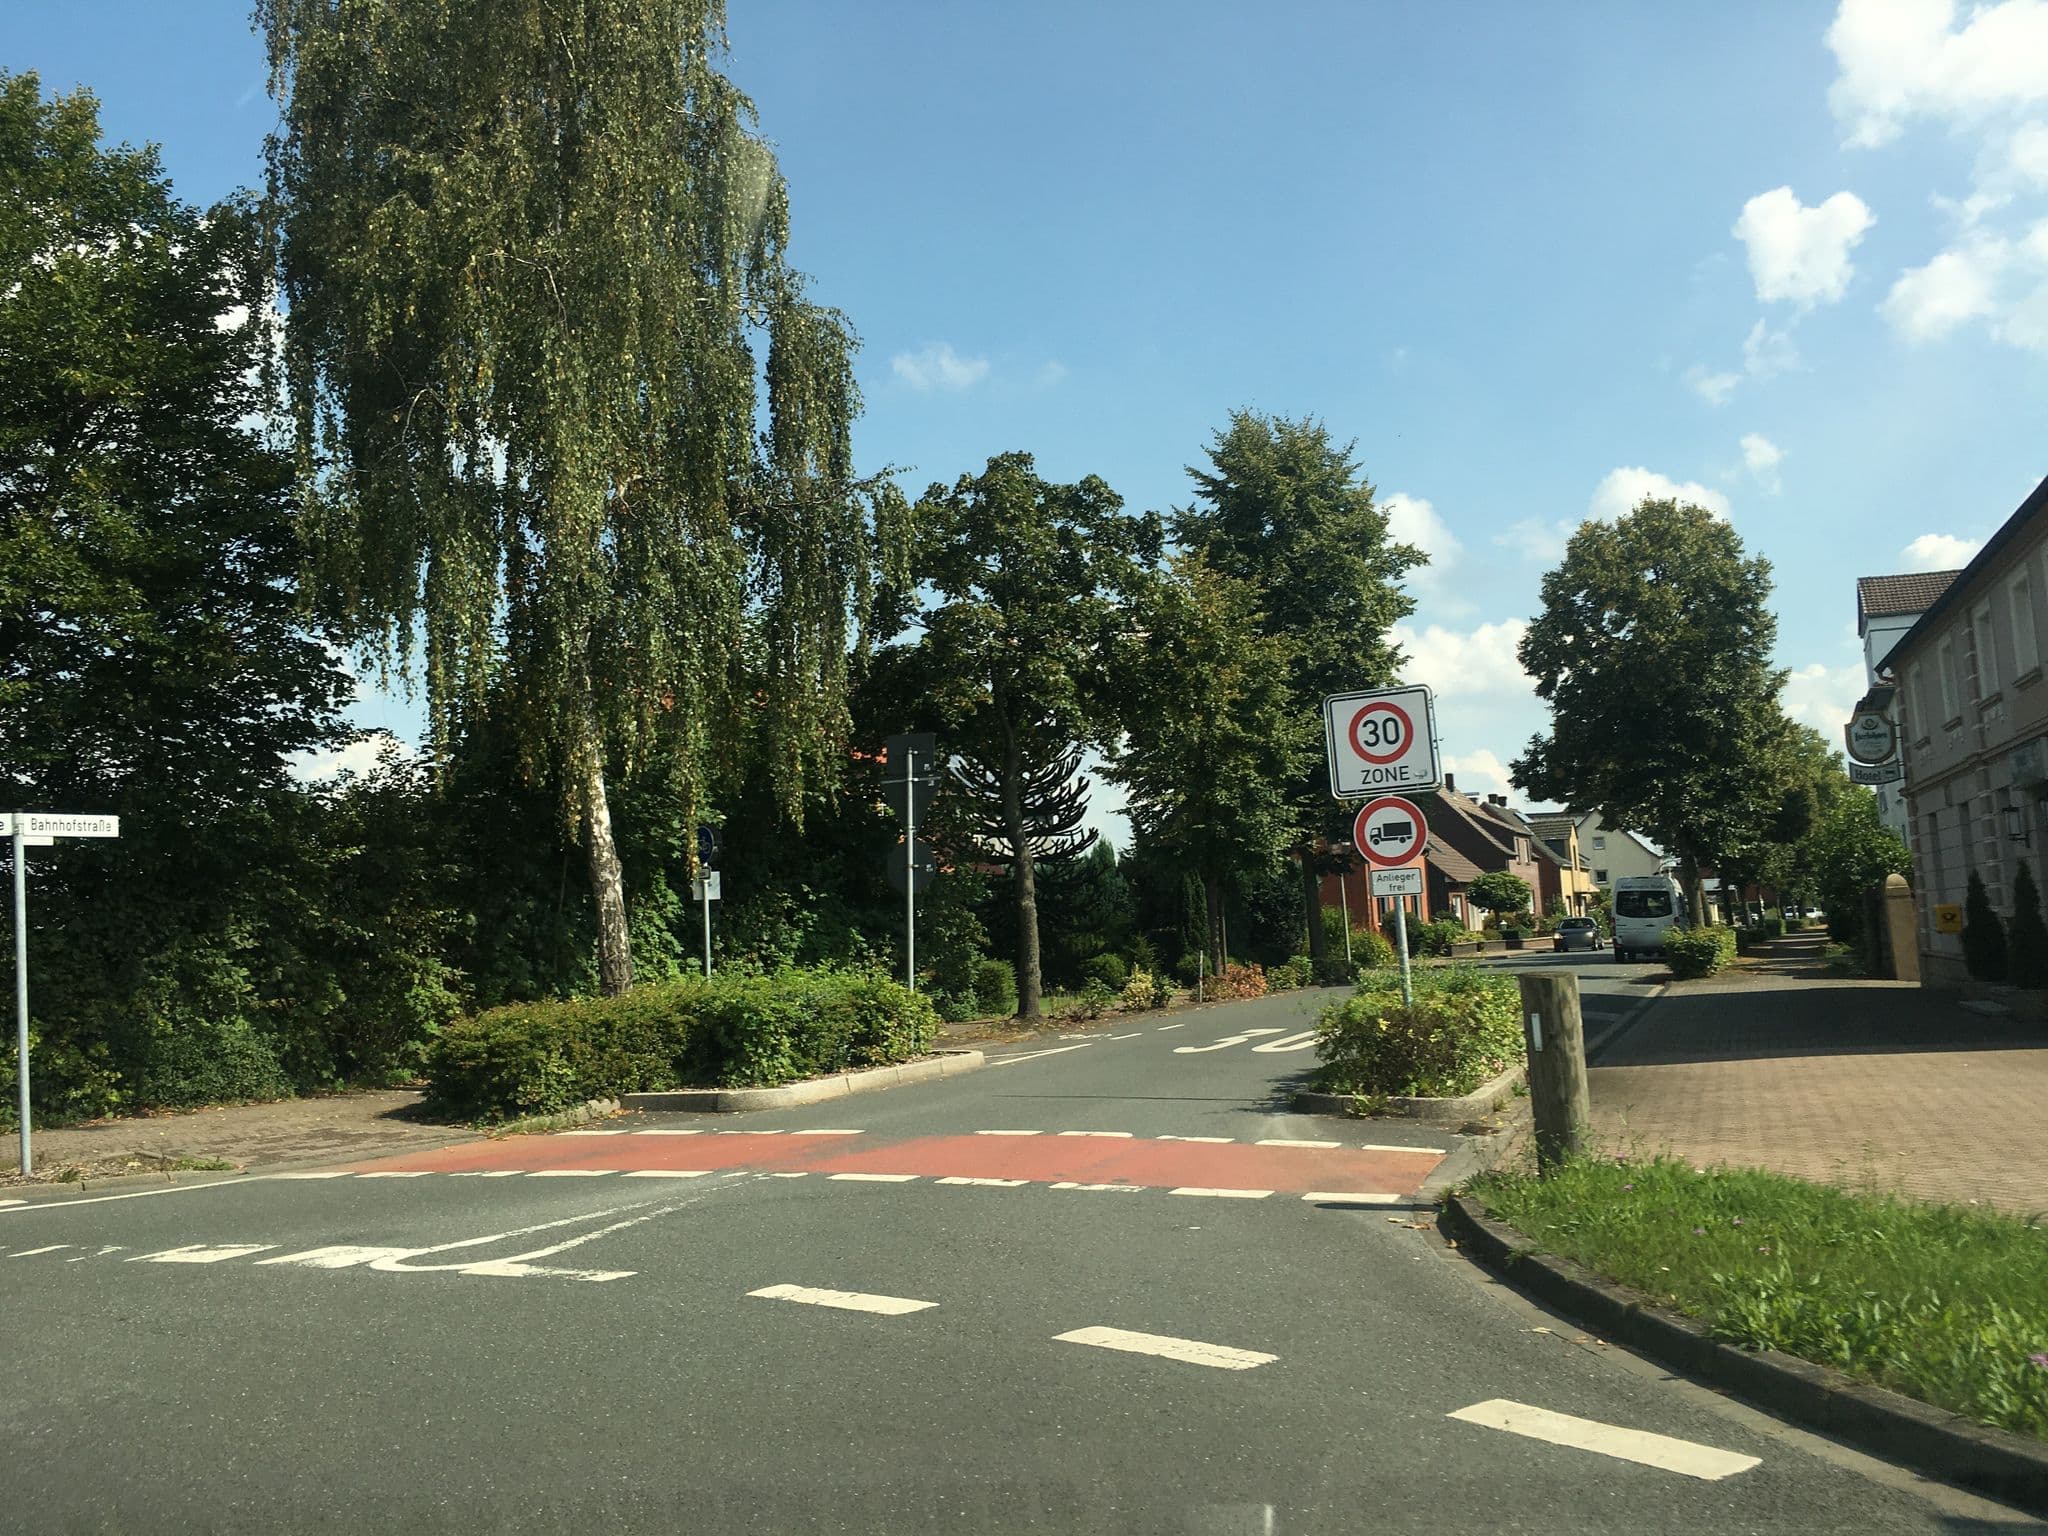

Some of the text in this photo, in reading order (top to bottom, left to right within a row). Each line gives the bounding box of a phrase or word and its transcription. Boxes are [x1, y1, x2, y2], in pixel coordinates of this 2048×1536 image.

[1362, 717, 1399, 747] 30
[1361, 766, 1410, 785] ZONE
[1855, 769, 1882, 781] Hotel
[31, 817, 112, 832] Bahnhofstraße
[1376, 873, 1416, 883] Anlieger
[1388, 883, 1406, 892] frei
